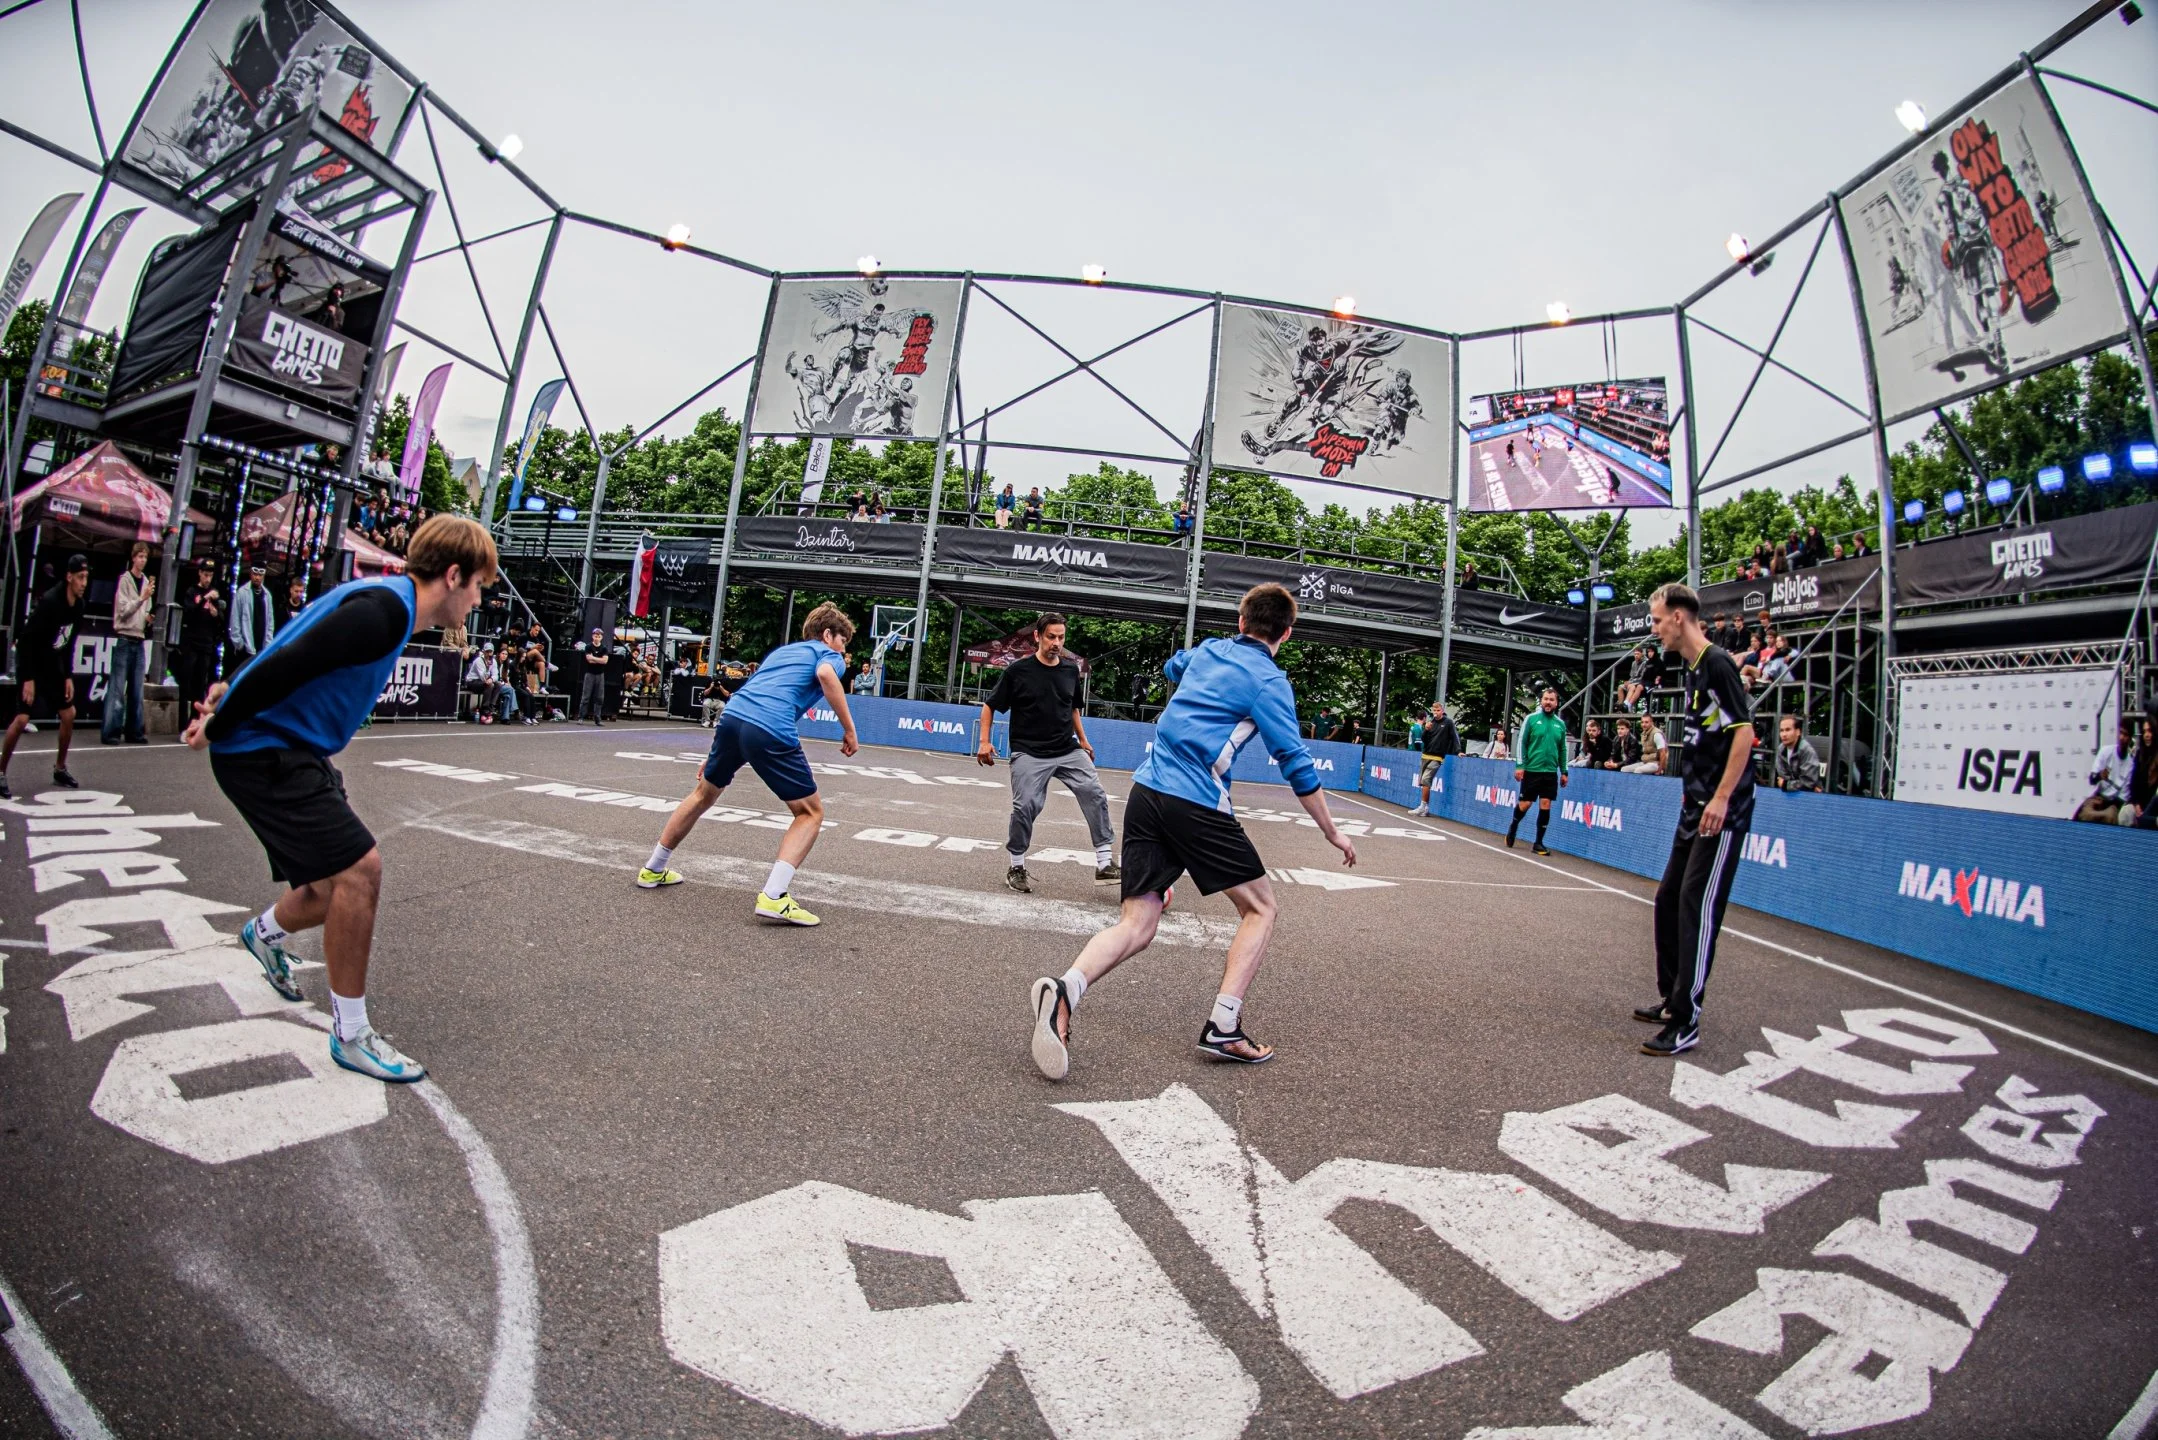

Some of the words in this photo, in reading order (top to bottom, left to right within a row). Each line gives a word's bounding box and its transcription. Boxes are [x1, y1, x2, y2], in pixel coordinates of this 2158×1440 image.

[1957, 131, 2003, 191] WAY
[1979, 173, 2015, 217] TO
[261, 311, 345, 371] GHETTO
[271, 349, 323, 385] GAMES
[1307, 425, 1366, 451] SUPERMAN
[1313, 445, 1356, 463] MODE
[1321, 462, 1342, 477] ON
[1012, 543, 1108, 568] MAXIMA
[1991, 532, 2053, 566] GHETTO
[2003, 558, 2043, 581] GAMES
[387, 656, 433, 685] ETTO
[898, 717, 965, 735] MAXIMA
[1371, 764, 1391, 782] MAXIMA
[1957, 747, 2042, 797] ISFA
[1475, 783, 1517, 808] MAXIMA
[1561, 799, 1622, 832] MAXIMA
[1898, 860, 2046, 928] MAXIMA
